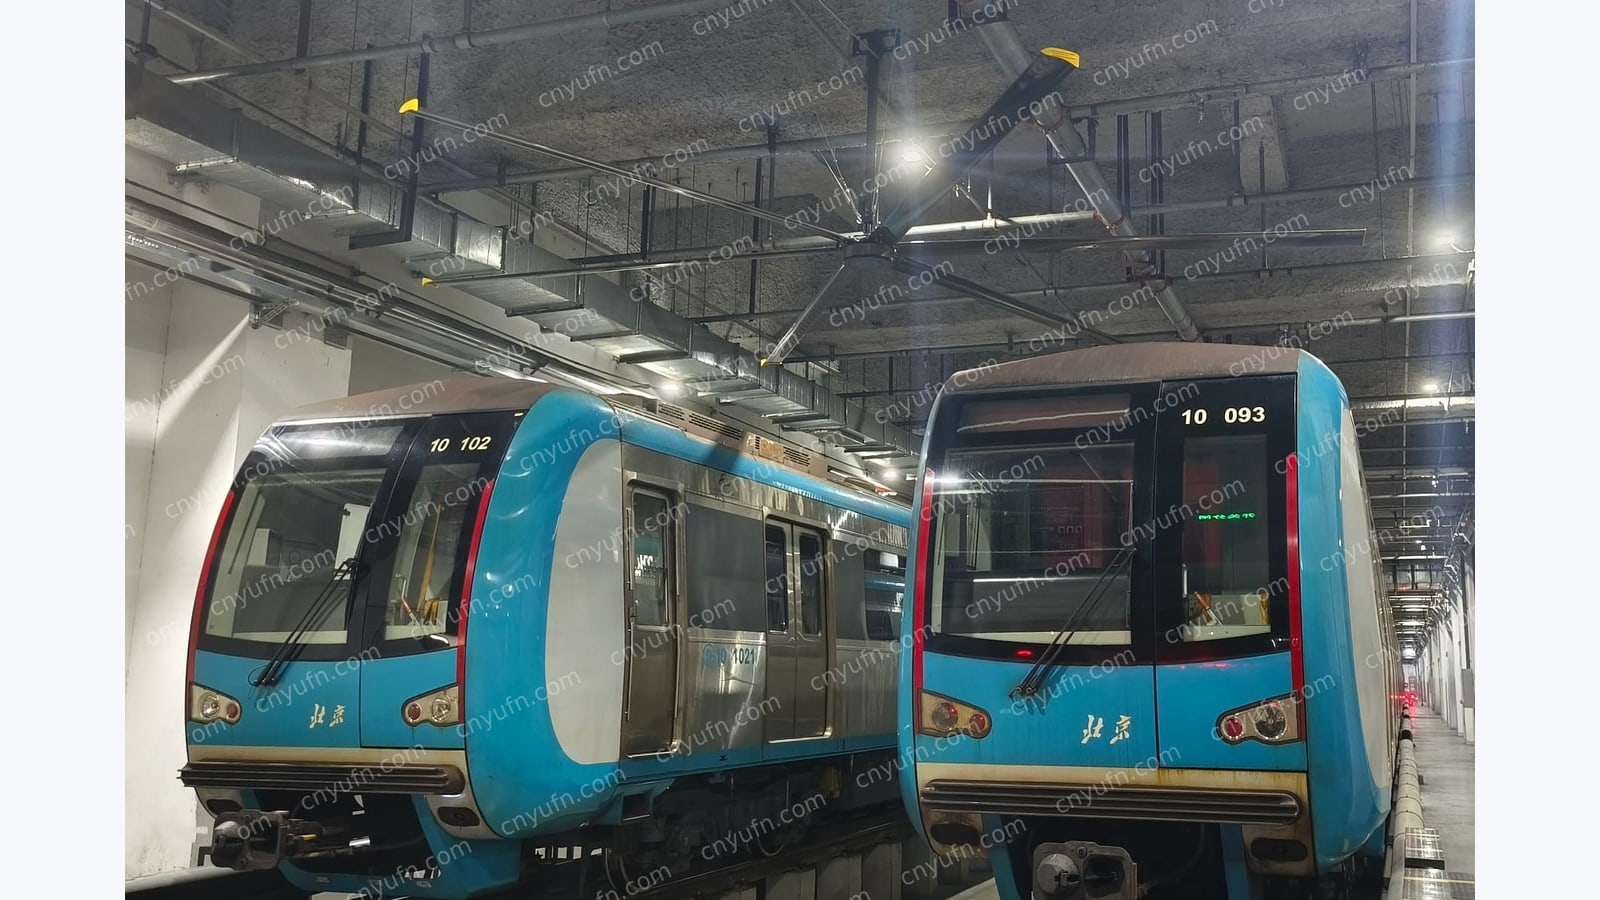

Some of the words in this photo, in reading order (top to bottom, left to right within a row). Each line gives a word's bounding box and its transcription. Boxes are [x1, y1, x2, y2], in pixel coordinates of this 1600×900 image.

[1181, 408, 1208, 425] 10
[1224, 406, 1266, 424] 093
[430, 438, 451, 453] 10
[460, 436, 492, 451] 102
[309, 703, 346, 729] 北京
[1081, 714, 1132, 745] 北京
